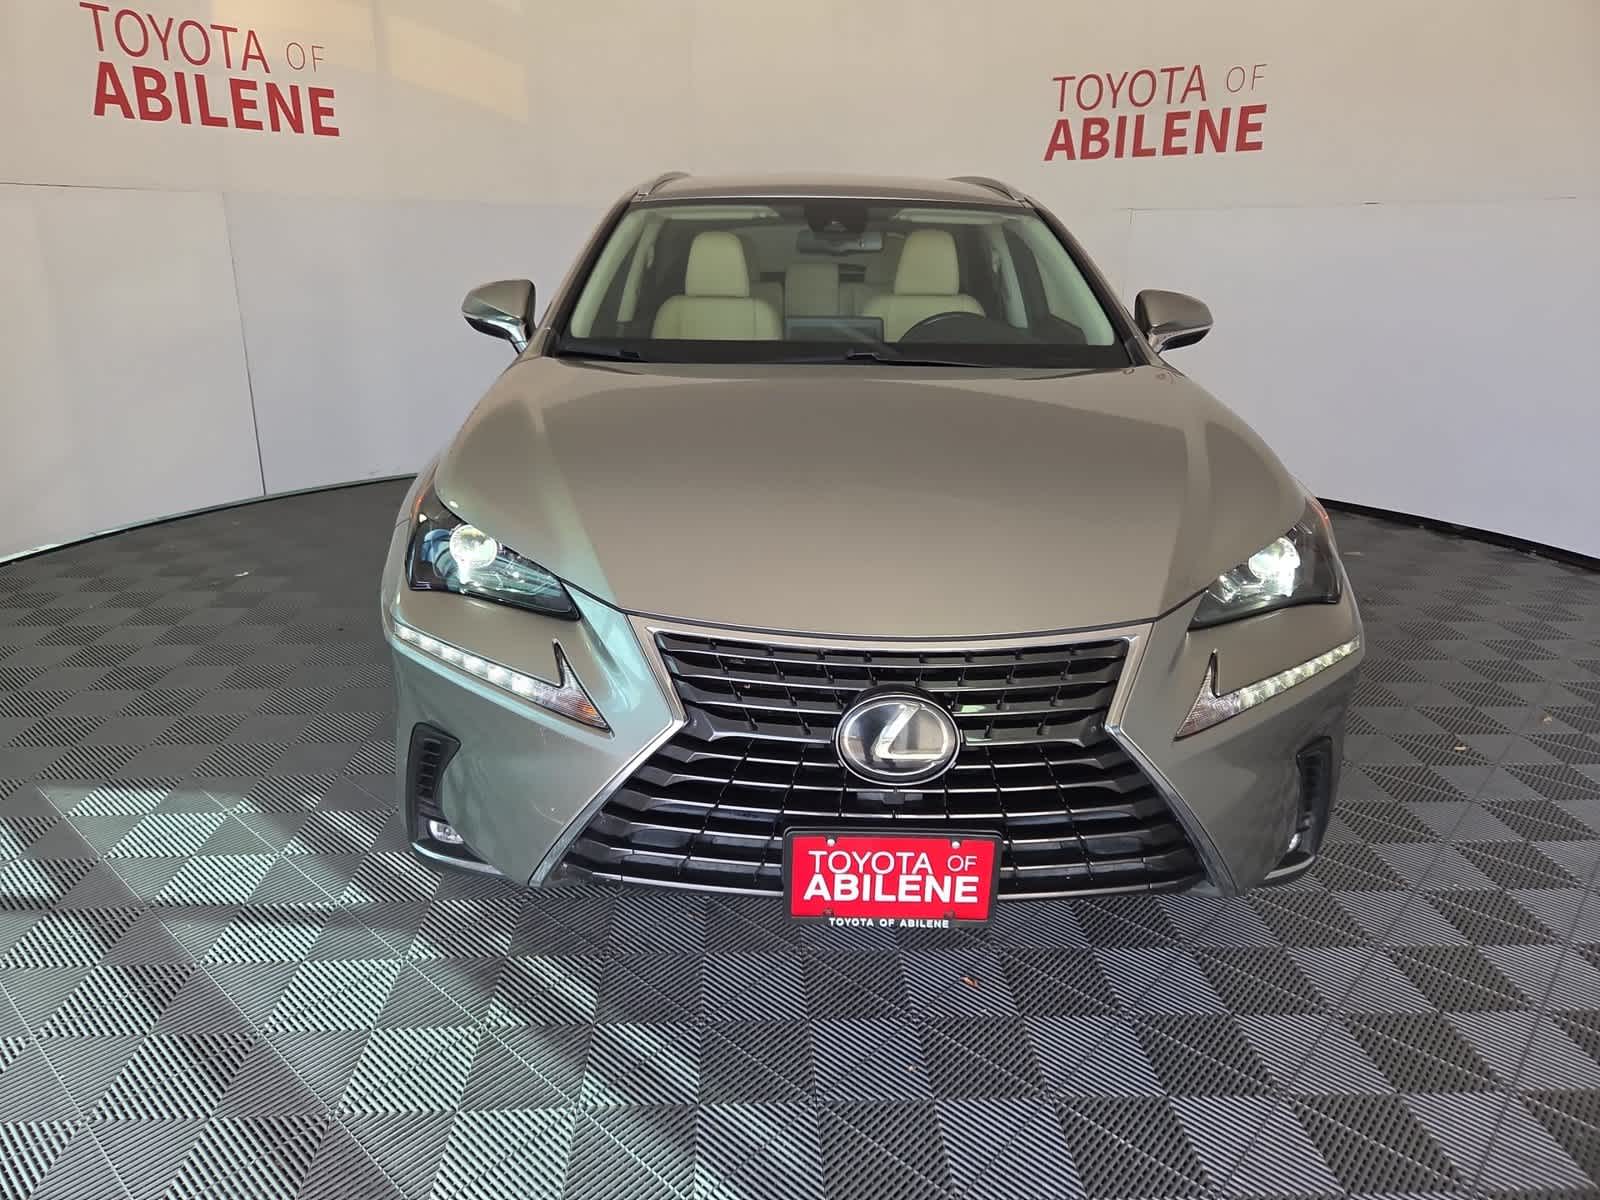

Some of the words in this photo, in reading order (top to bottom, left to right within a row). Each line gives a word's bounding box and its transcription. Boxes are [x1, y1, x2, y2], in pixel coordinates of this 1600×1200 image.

[79, 2, 271, 74] TOYOTA
[286, 42, 325, 73] OF
[93, 61, 340, 137] ABILENE
[1052, 64, 1207, 112] TOYOTA
[1226, 63, 1268, 93] OF
[1043, 103, 1268, 161] ABILENE
[808, 850, 933, 875] TOYOTA
[947, 855, 977, 872] OF
[803, 873, 980, 903] ABILENE
[829, 918, 874, 928] TOYOTA
[879, 918, 895, 928] OF
[900, 918, 950, 929] ABILENE
